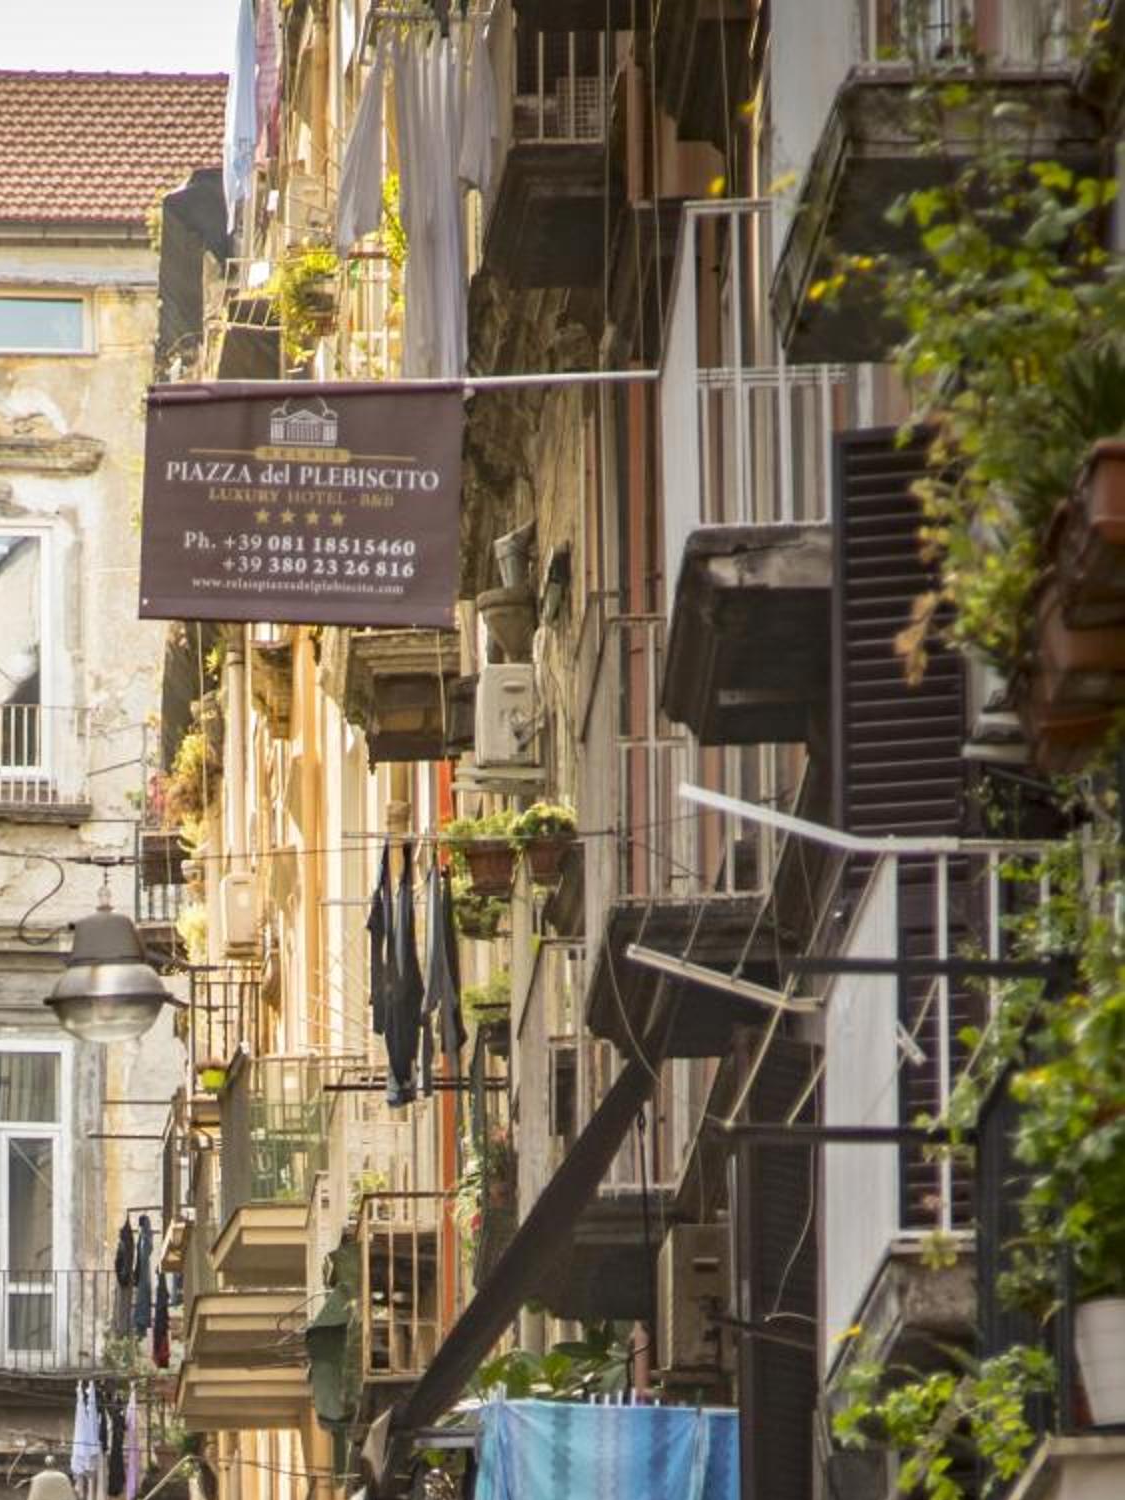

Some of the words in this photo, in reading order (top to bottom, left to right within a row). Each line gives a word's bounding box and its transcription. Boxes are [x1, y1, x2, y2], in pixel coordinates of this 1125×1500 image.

[166, 461, 252, 484] PIAZZA
[260, 464, 291, 485] del
[299, 466, 440, 491] PLEBISCITO
[208, 486, 280, 503] LUXURY
[288, 489, 348, 507] HOTEL
[359, 493, 395, 508] B&B
[183, 530, 216, 549] Ph.
[223, 533, 262, 550] +39
[268, 535, 305, 552] 081
[313, 536, 416, 557] 18515460
[222, 555, 262, 573] +39
[268, 557, 307, 574] 380
[313, 558, 338, 575] 23
[345, 559, 370, 577] 26
[376, 560, 415, 579] 816
